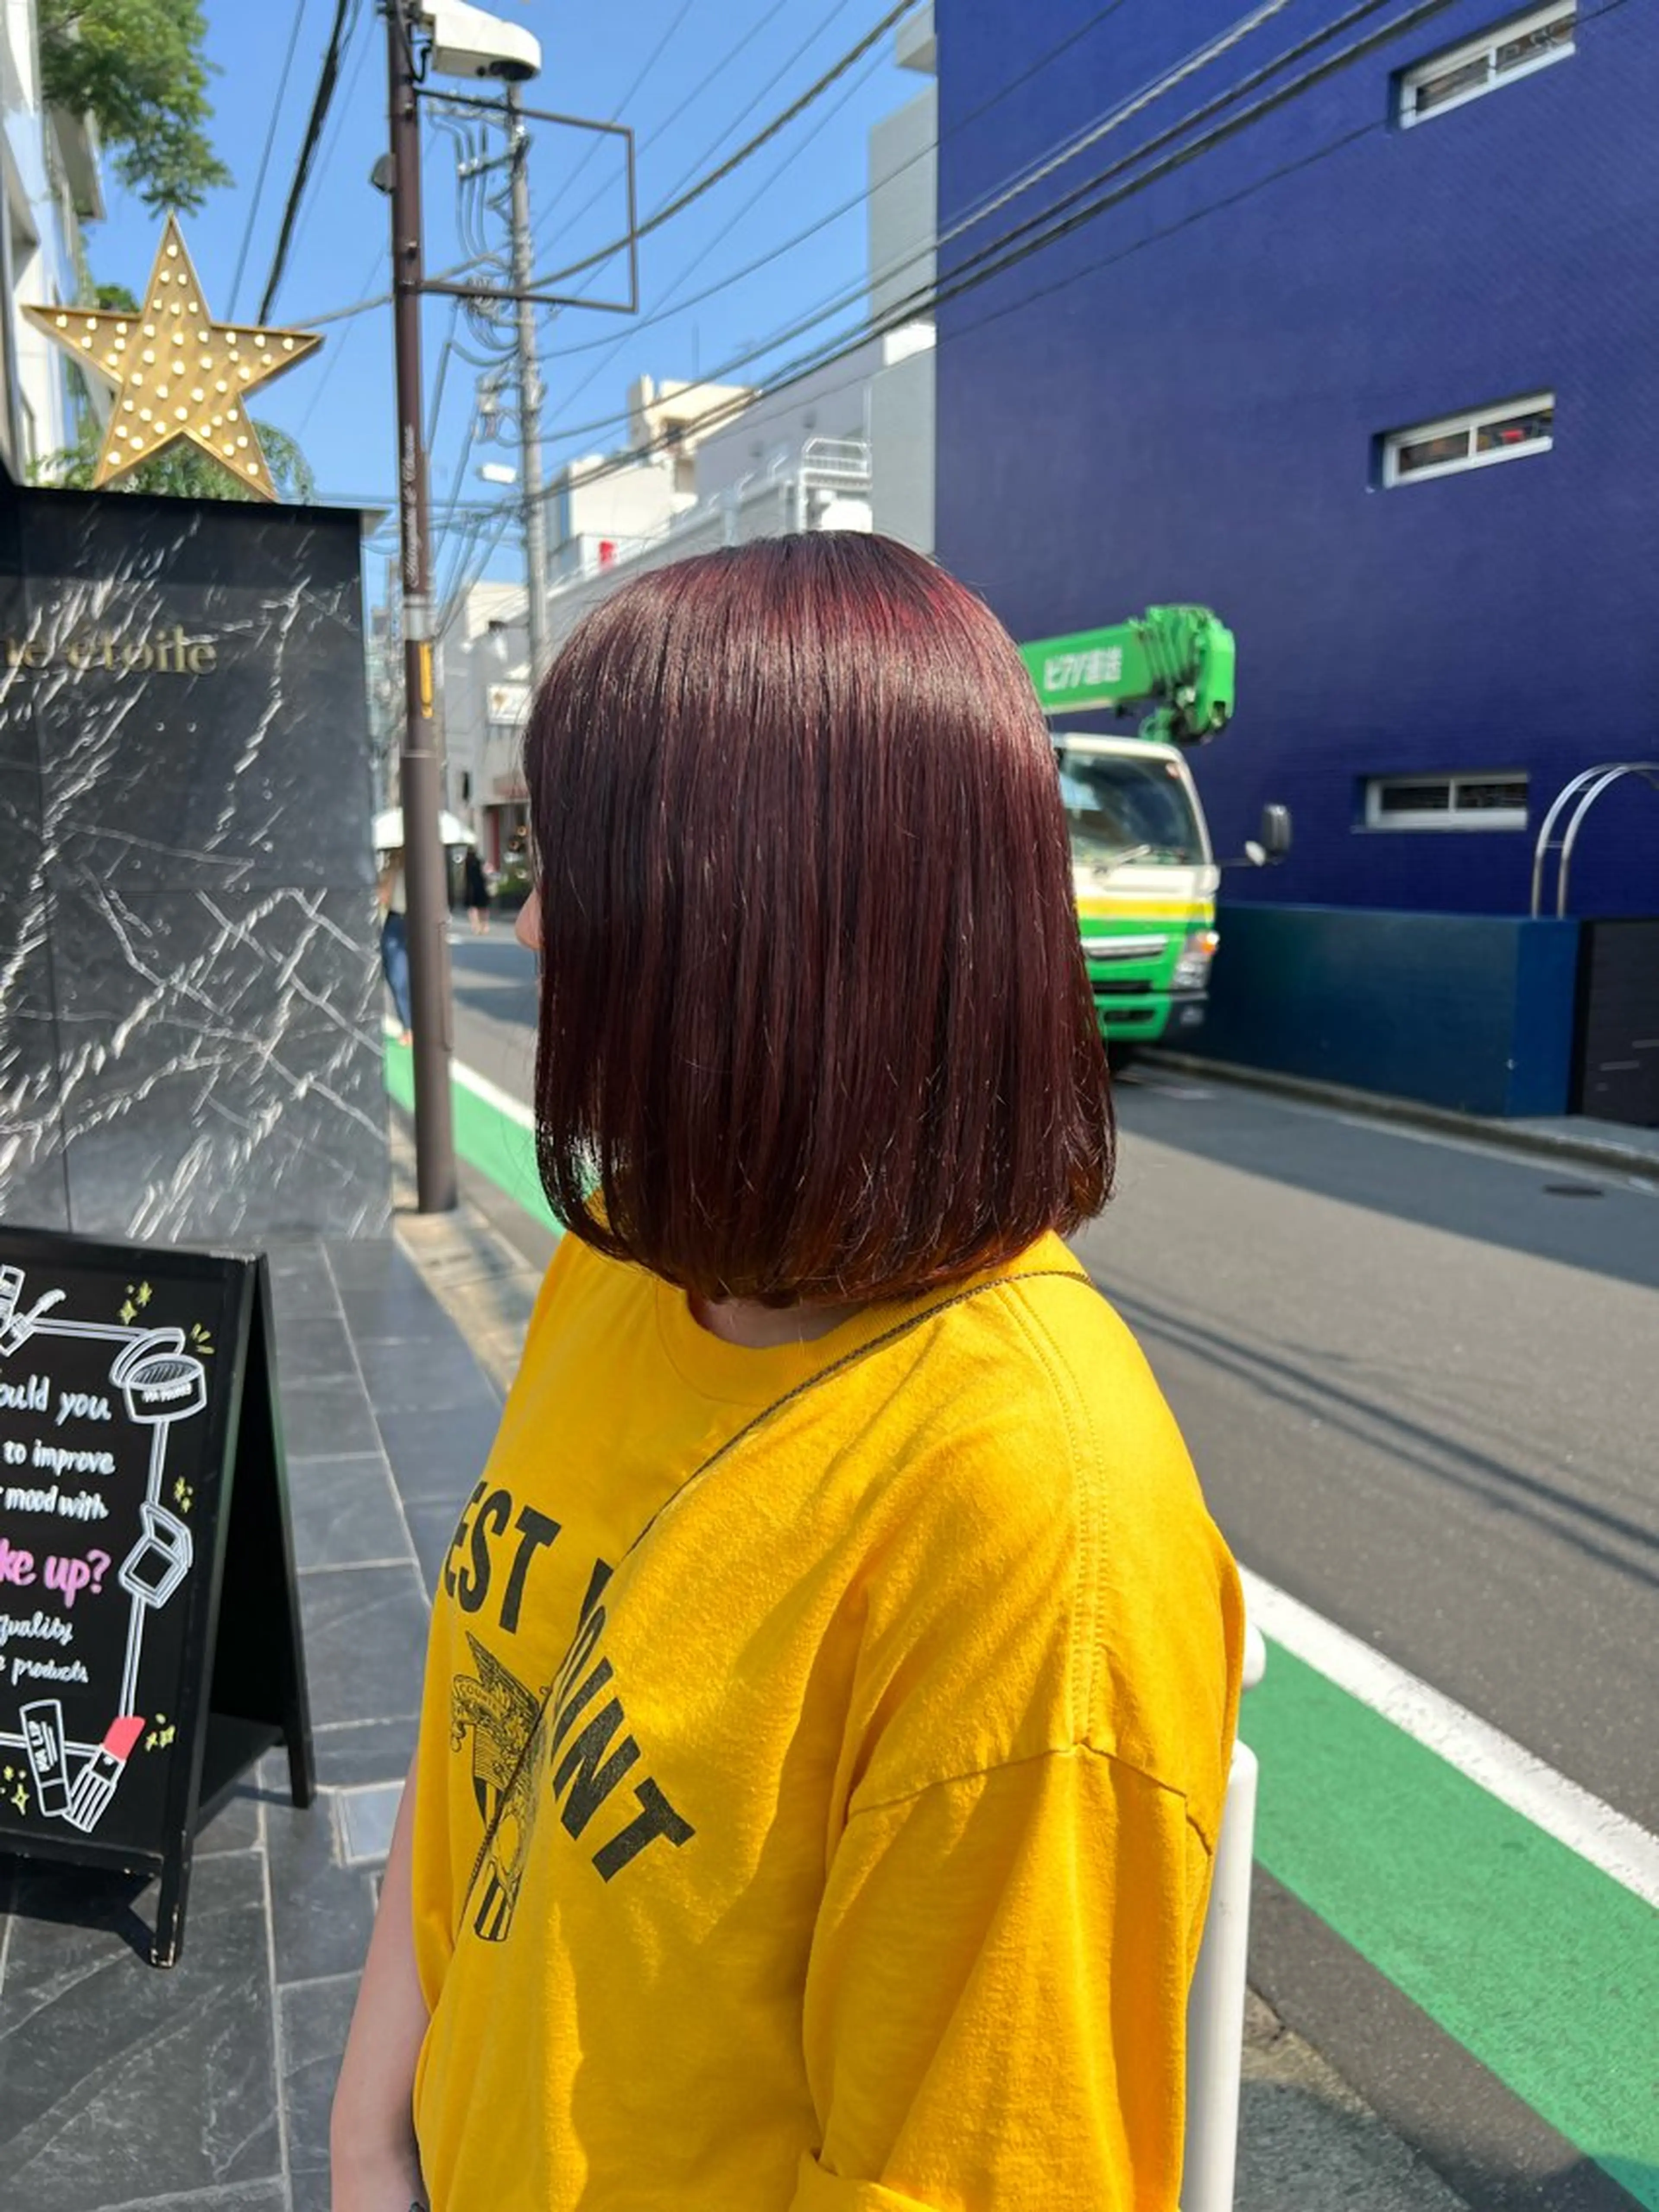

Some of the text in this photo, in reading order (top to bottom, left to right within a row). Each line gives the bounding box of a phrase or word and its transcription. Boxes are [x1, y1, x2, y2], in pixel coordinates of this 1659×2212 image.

[54, 1392, 112, 1426] you
[3, 1439, 115, 1476] to improve
[4, 1484, 109, 1521] mood with
[44, 1549, 111, 1609] up?
[11, 1657, 89, 1686] products
